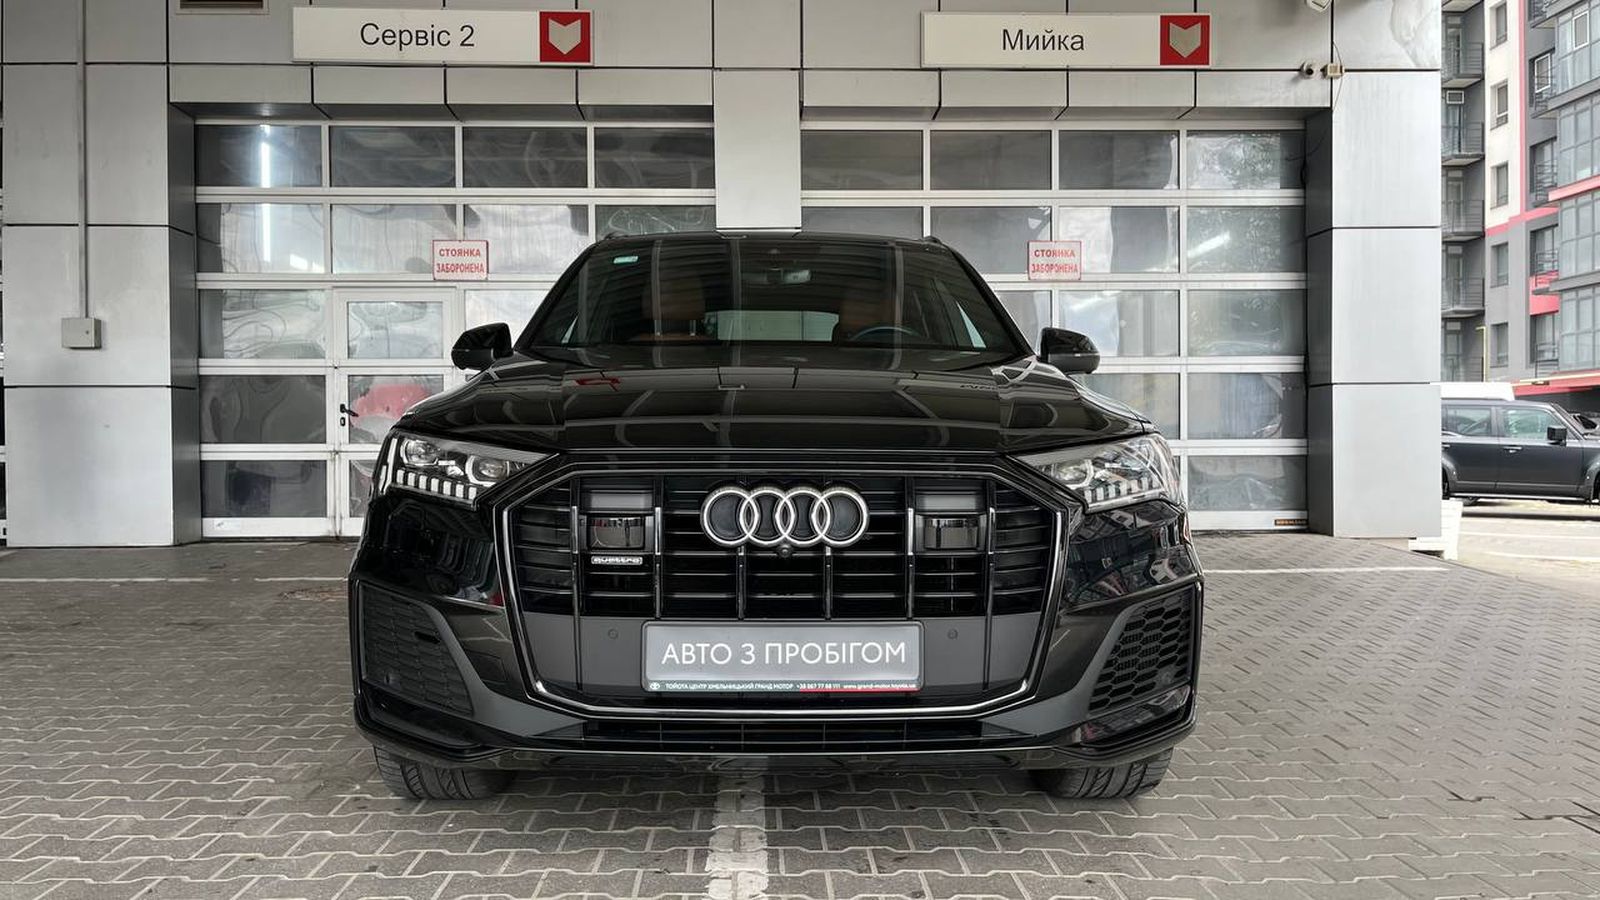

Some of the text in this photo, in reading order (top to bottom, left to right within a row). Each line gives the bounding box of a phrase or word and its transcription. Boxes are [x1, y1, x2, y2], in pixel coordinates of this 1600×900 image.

[360, 22, 475, 51] Сервіс 2
[1002, 28, 1084, 51] Мийка
[439, 248, 481, 257] СТОЯНКА
[1034, 249, 1076, 258] СТОЯНКА
[436, 262, 485, 273] ЗАБОРОНЕНА
[1031, 263, 1079, 273] ЗАБОРОНЕНА
[592, 556, 643, 565] quattro
[661, 643, 733, 665] АВТО
[764, 642, 907, 665] ПРОБІГОМ
